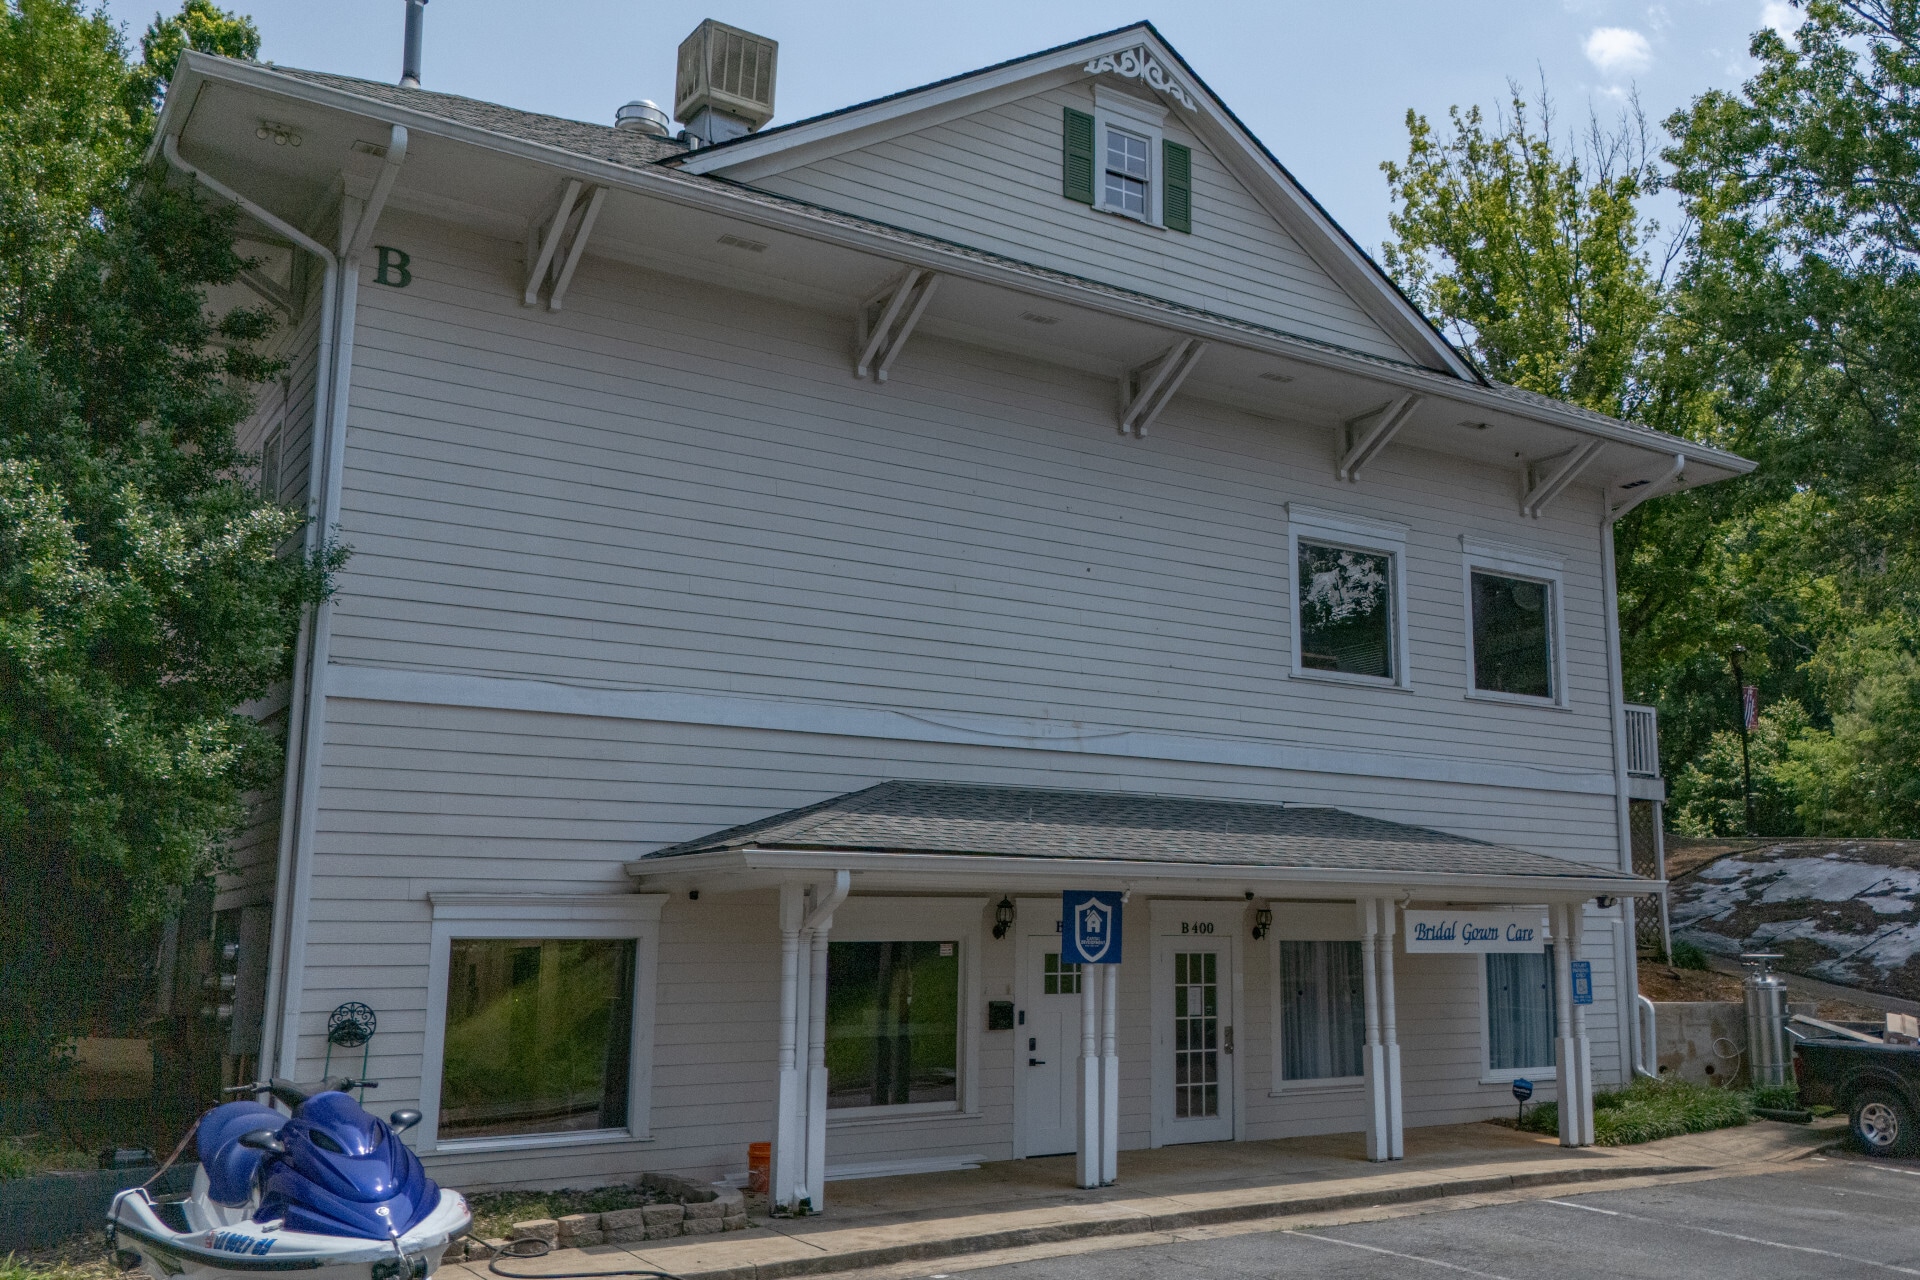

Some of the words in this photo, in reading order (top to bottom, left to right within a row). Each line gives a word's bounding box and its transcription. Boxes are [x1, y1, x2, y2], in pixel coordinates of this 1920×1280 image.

[372, 245, 412, 288] B
[1181, 922, 1190, 934] B
[1191, 921, 1214, 934] 400
[1414, 921, 1458, 941] Bridal
[1462, 923, 1499, 946] Gown
[1506, 923, 1534, 942] Care
